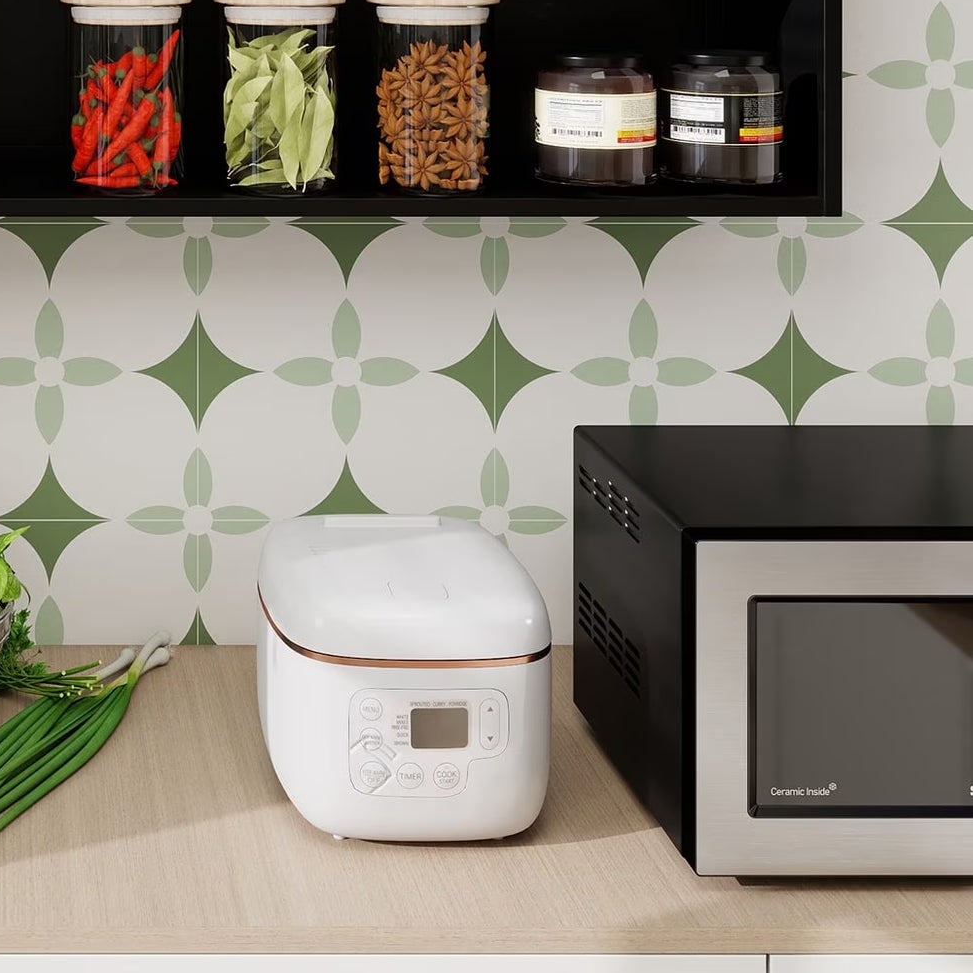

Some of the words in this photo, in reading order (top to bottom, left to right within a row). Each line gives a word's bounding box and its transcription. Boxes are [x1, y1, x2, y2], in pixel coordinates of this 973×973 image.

[399, 772, 422, 780] TIMER
[436, 770, 458, 779] COOK
[770, 786, 806, 796] Ceramic
[806, 786, 831, 796] Inside
